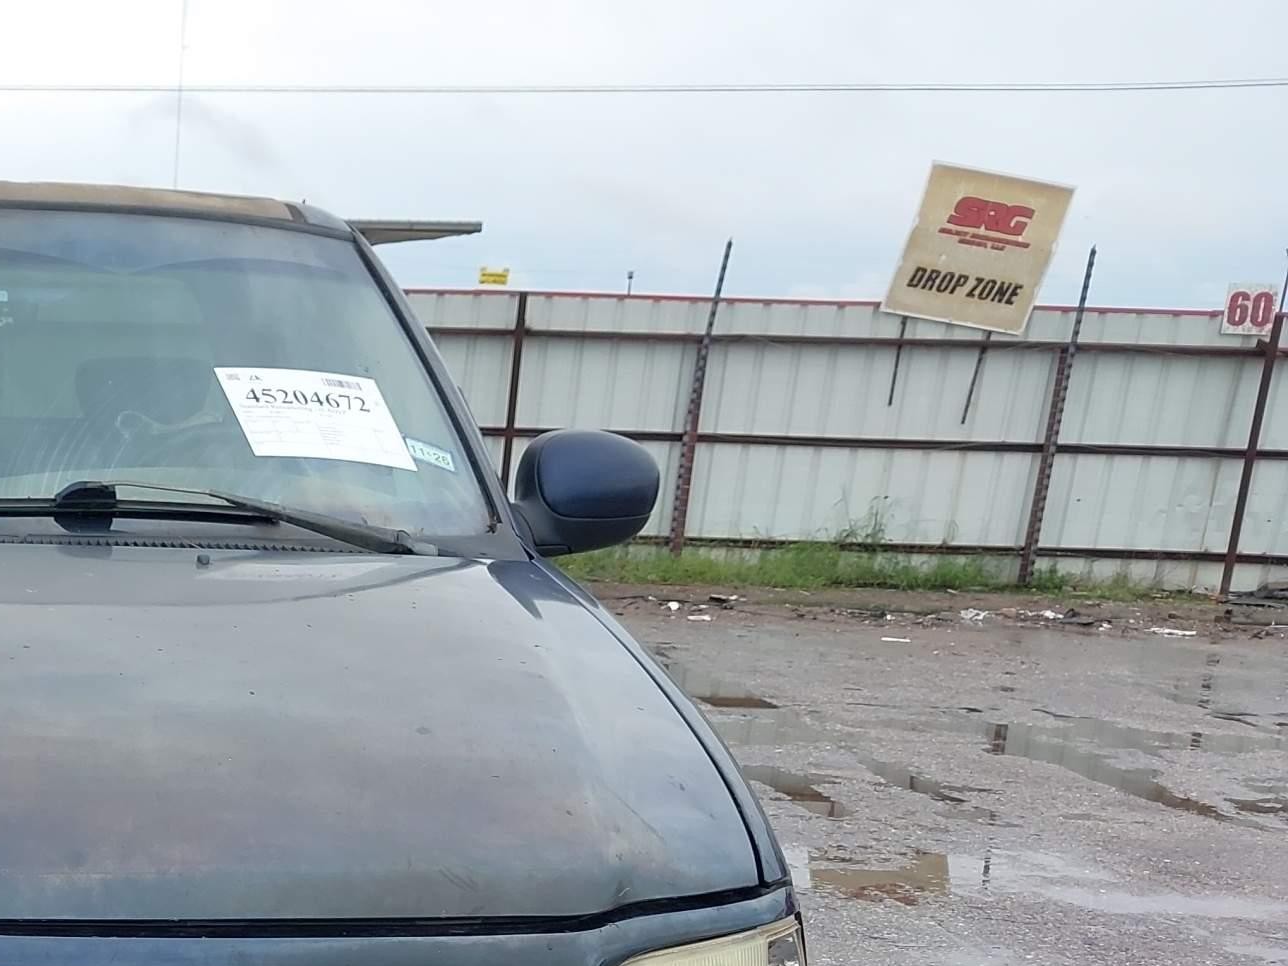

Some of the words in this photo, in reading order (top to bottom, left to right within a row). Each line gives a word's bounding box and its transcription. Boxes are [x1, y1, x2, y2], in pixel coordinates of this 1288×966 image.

[946, 196, 1035, 236] SRG
[906, 266, 970, 296] DROP
[965, 276, 1024, 306] ZONE
[1226, 290, 1274, 327] 60
[245, 387, 371, 413] 45204672
